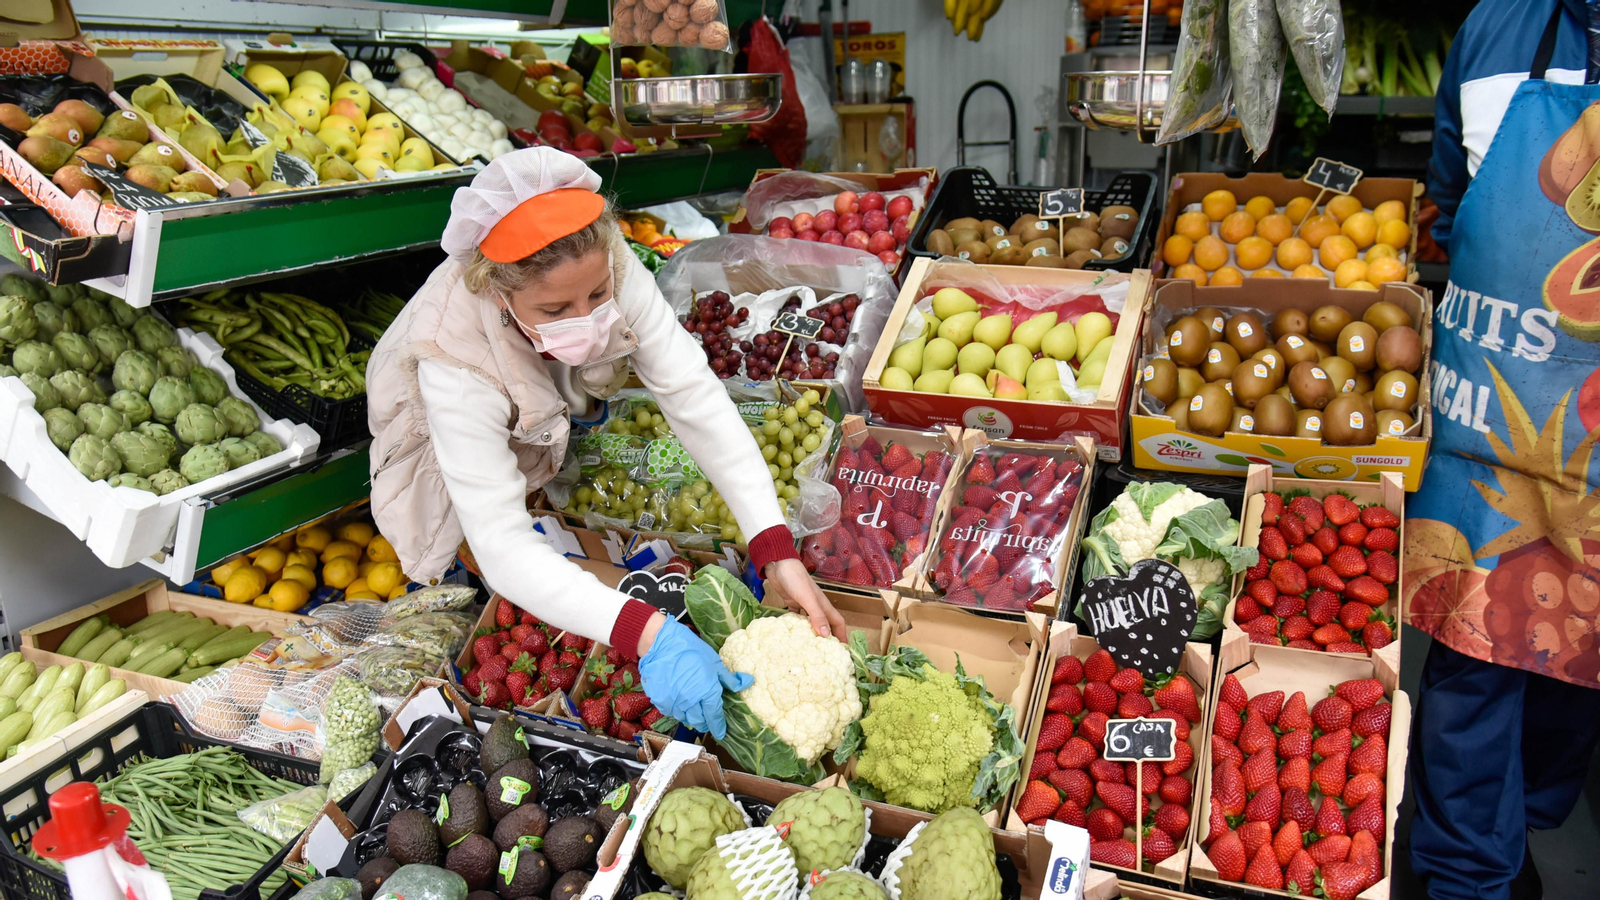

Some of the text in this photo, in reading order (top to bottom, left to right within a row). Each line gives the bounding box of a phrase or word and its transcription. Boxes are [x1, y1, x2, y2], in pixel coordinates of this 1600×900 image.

[94, 168, 120, 179] DE
[1318, 161, 1331, 185] 4
[110, 182, 139, 192] LA
[1045, 190, 1064, 215] 5
[780, 314, 799, 330] 3
[1157, 443, 1203, 458] Zespri
[1355, 456, 1403, 465] SUNGOLD
[1087, 586, 1170, 636] HUELVA
[1109, 723, 1131, 753] 6
[1143, 745, 1154, 757] €
[1053, 858, 1071, 893] Melinda
